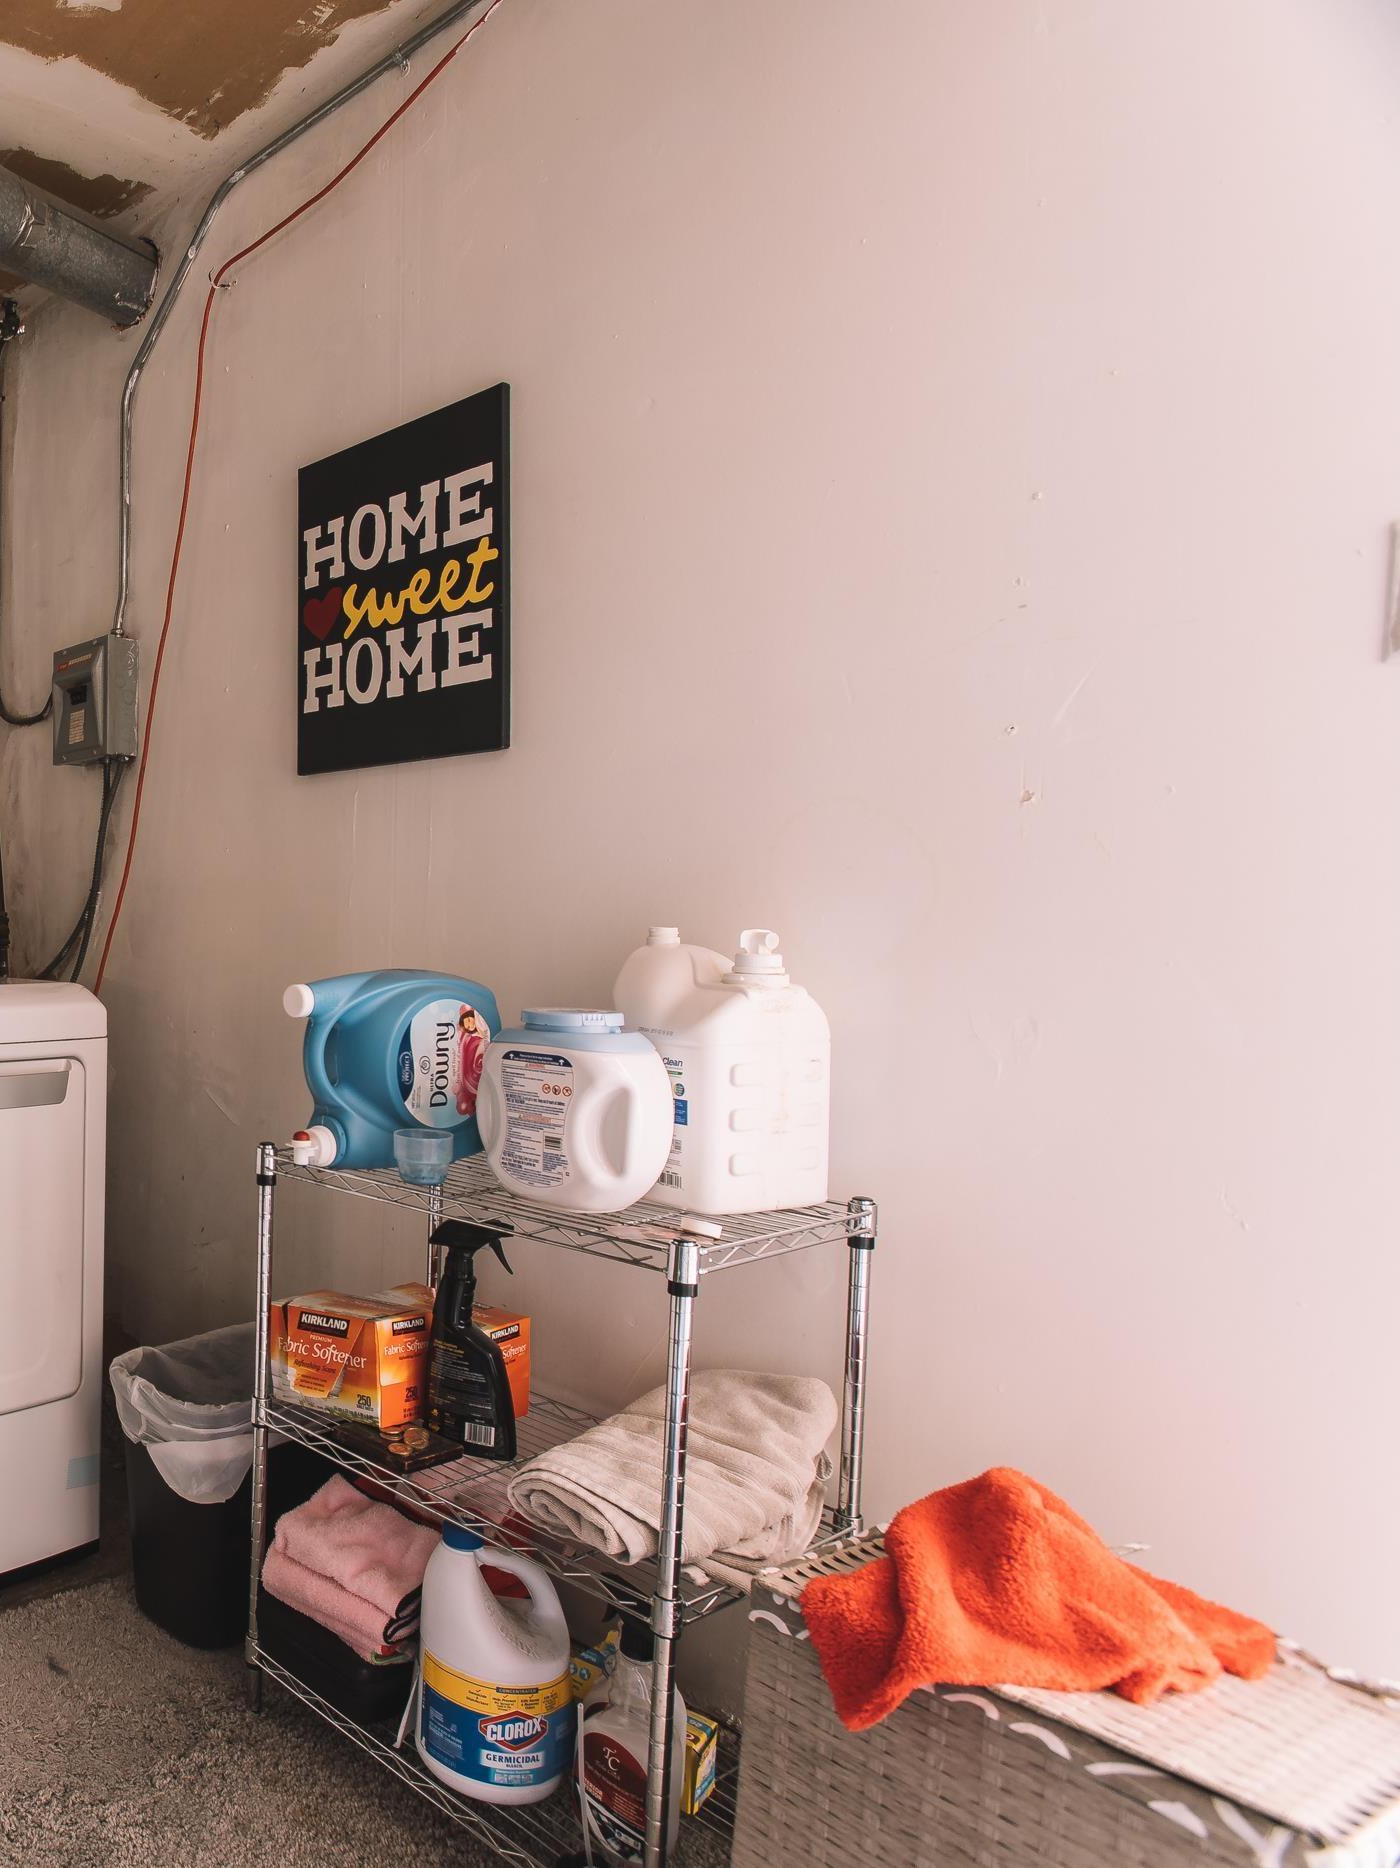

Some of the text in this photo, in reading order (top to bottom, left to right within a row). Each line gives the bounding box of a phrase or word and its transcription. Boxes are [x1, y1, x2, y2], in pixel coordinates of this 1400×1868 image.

[304, 461, 493, 590] HOME
[342, 536, 499, 640] sweet
[304, 608, 493, 714] HOME
[429, 1022, 456, 1108] Downy
[301, 1313, 348, 1331] KIRKLAND
[393, 1318, 424, 1331] KIRKLAND
[309, 1334, 332, 1343] PREMIUM
[491, 1325, 519, 1340] KIRKLAND
[278, 1336, 367, 1368] Fabric Softener
[384, 1344, 405, 1356] Fabric
[502, 1344, 526, 1359] Softener
[357, 1393, 372, 1407] 250
[486, 1717, 542, 1741] CLOROX
[486, 1753, 540, 1764] GERMICIDAL
